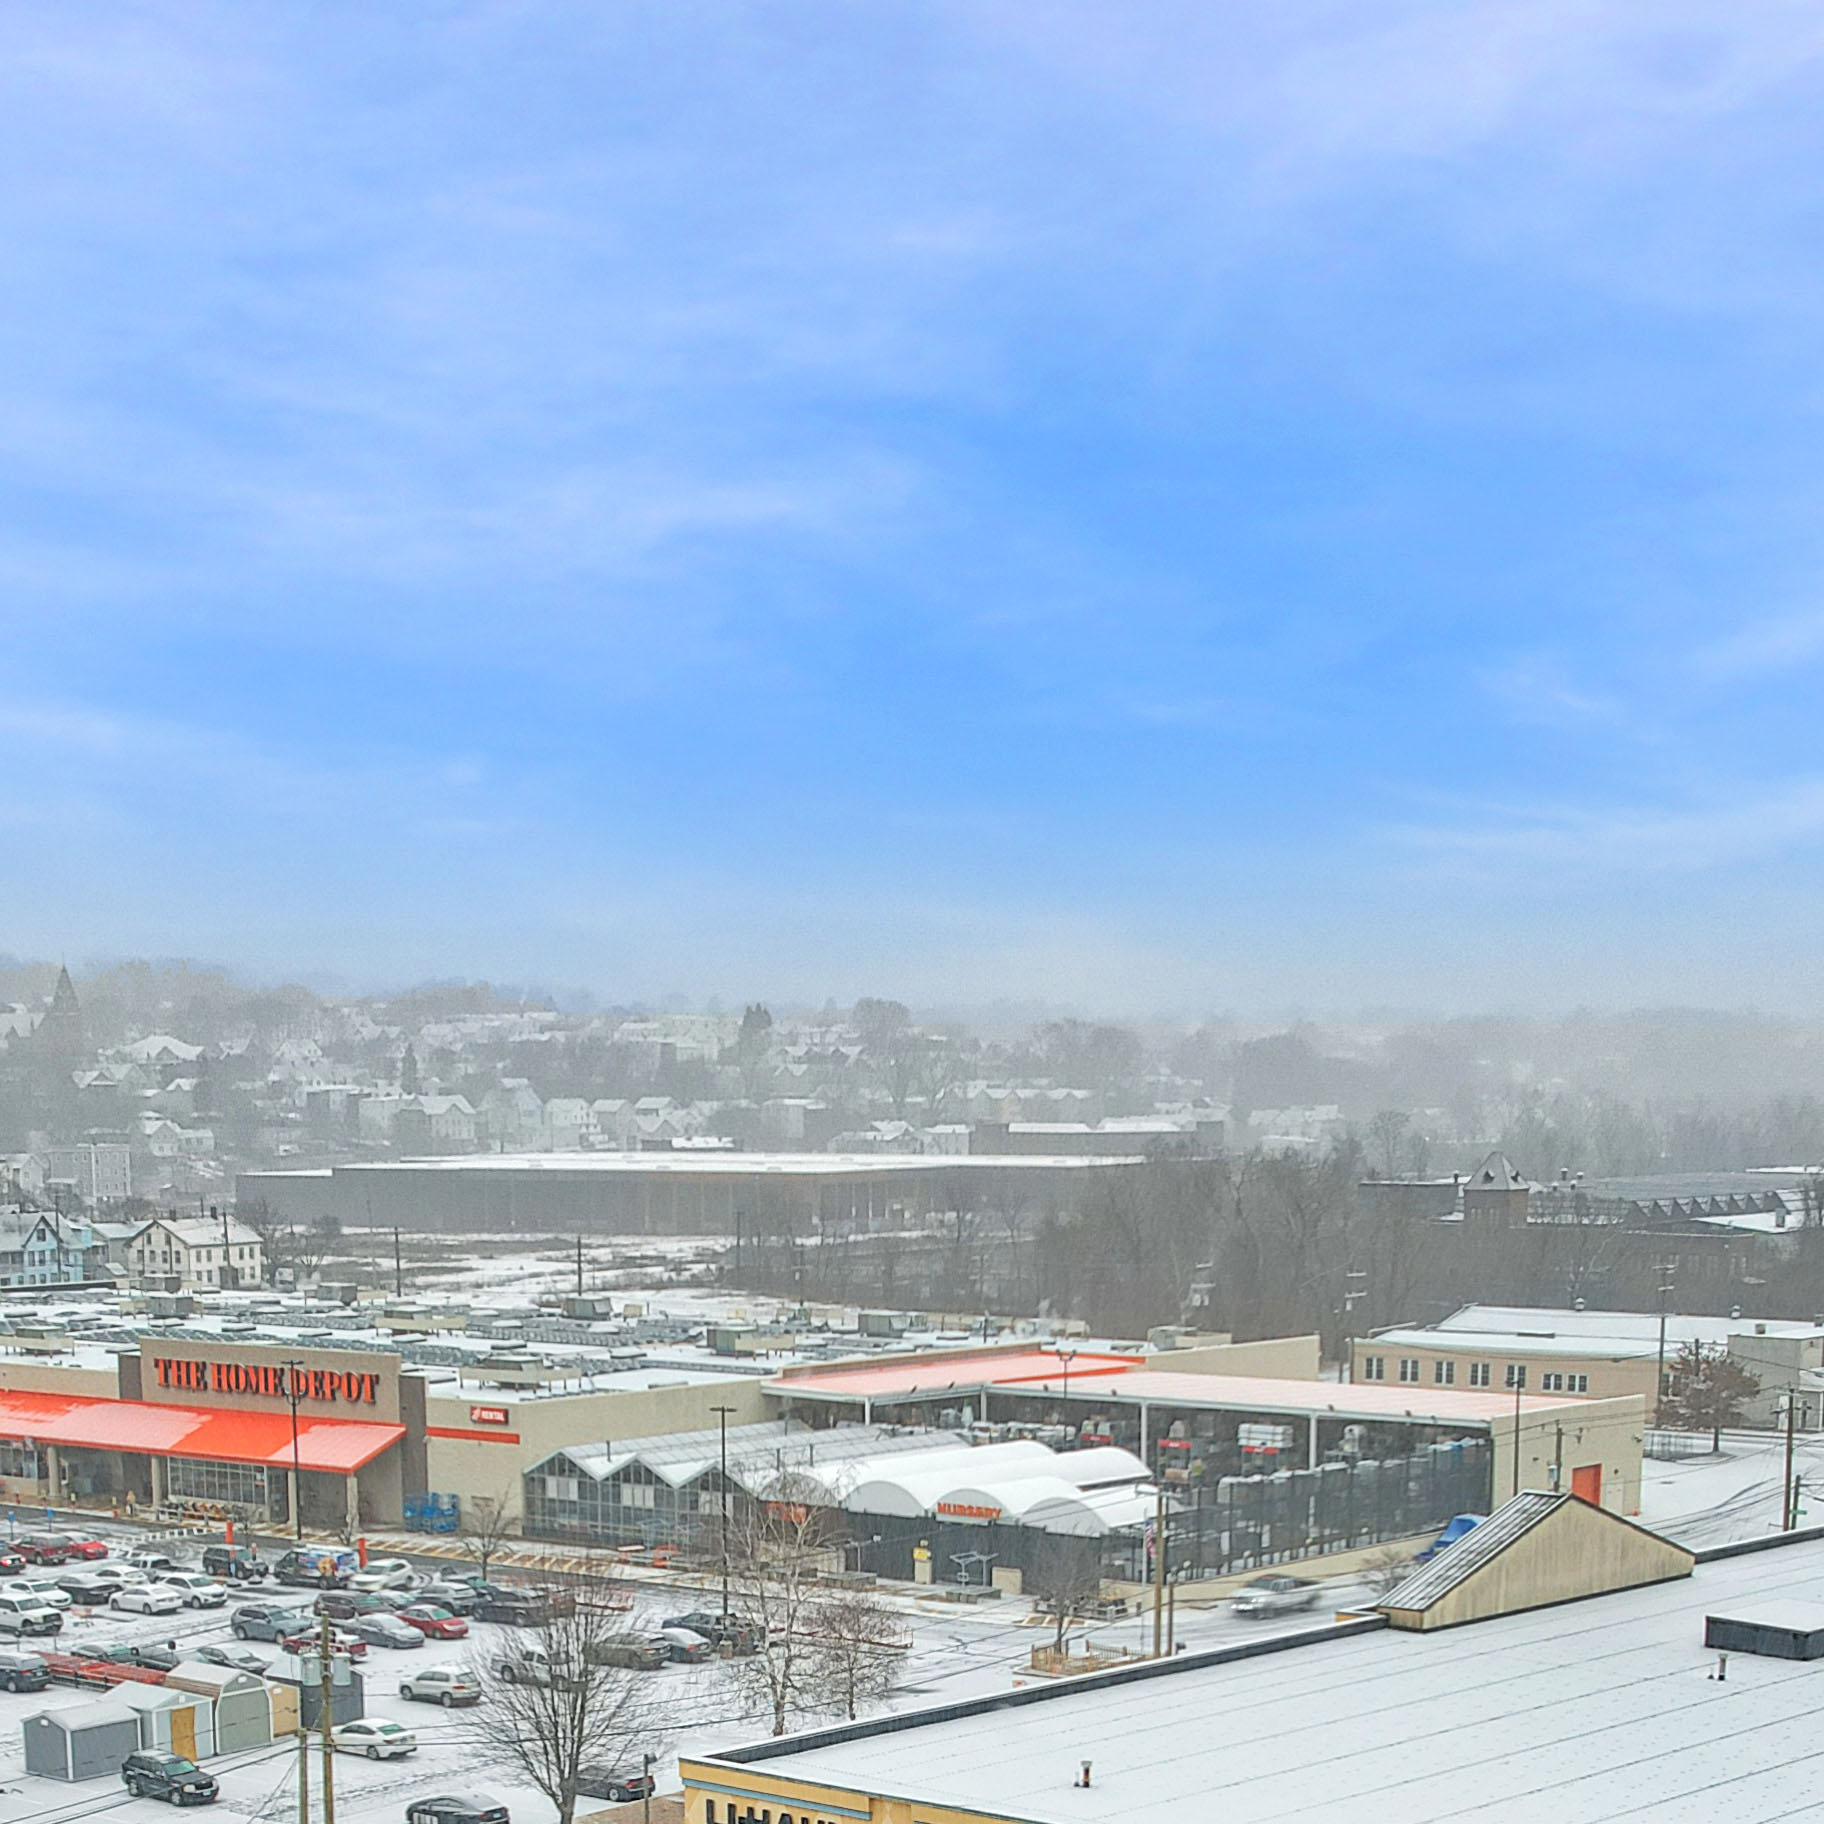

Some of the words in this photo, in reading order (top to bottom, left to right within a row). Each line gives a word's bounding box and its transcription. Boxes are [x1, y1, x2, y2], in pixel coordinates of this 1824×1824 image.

[153, 1357, 208, 1392] THE
[210, 1362, 285, 1397] HOME
[289, 1367, 380, 1405] DEPOT
[937, 1501, 1002, 1520] NURSERY
